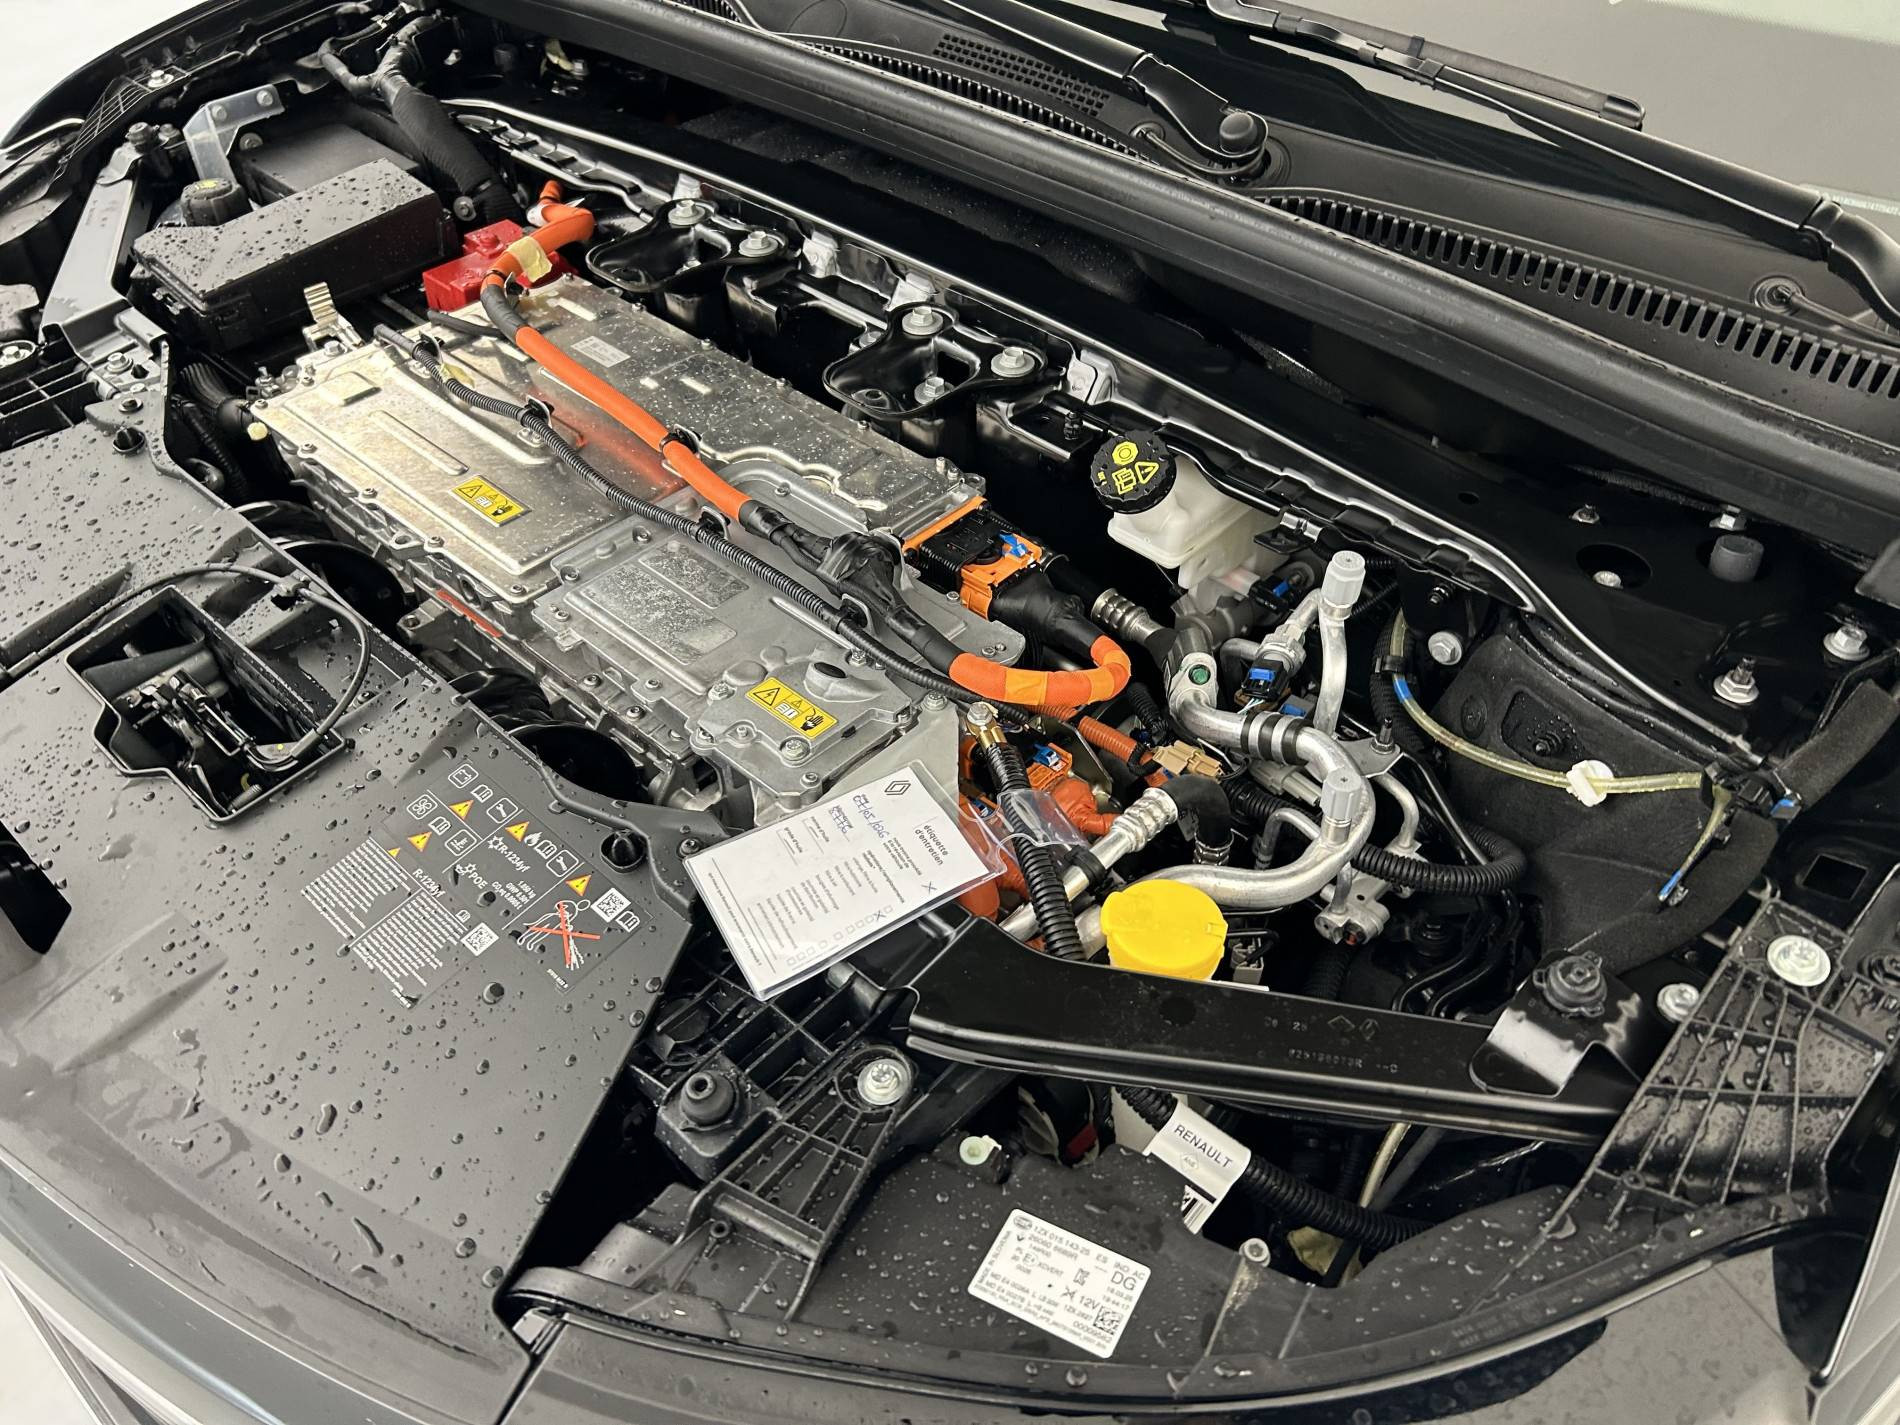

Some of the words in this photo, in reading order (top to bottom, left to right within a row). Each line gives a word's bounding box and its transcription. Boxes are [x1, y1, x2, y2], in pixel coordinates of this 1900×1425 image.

[914, 828, 943, 865] d'entretien
[923, 824, 948, 855] étiquette
[498, 845, 530, 870] R-1234yf
[412, 868, 445, 897] R-1234yf
[468, 871, 487, 889] POE
[1174, 1124, 1232, 1167] RENAULT
[1110, 1271, 1137, 1291] DG
[1078, 1295, 1099, 1310] 12V
